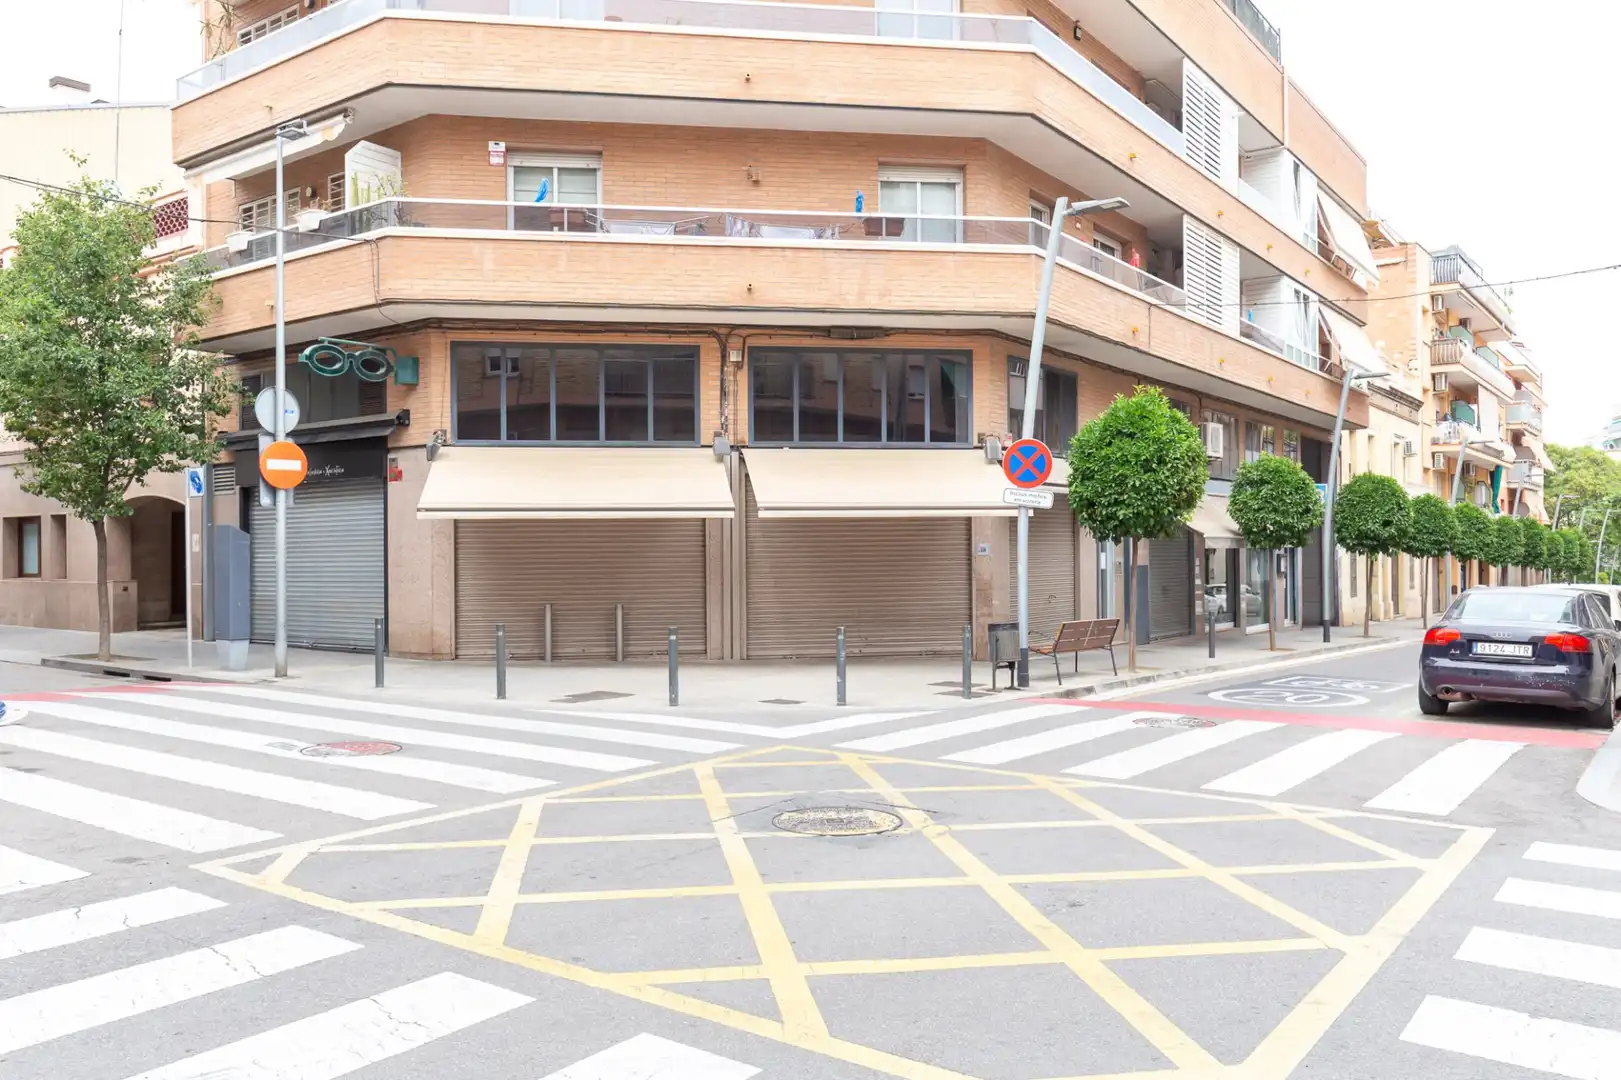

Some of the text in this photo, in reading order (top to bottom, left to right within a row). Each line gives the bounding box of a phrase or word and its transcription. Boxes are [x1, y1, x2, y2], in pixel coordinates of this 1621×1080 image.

[1480, 644, 1530, 655] 9124 JTR
[1232, 690, 1330, 703] 20
